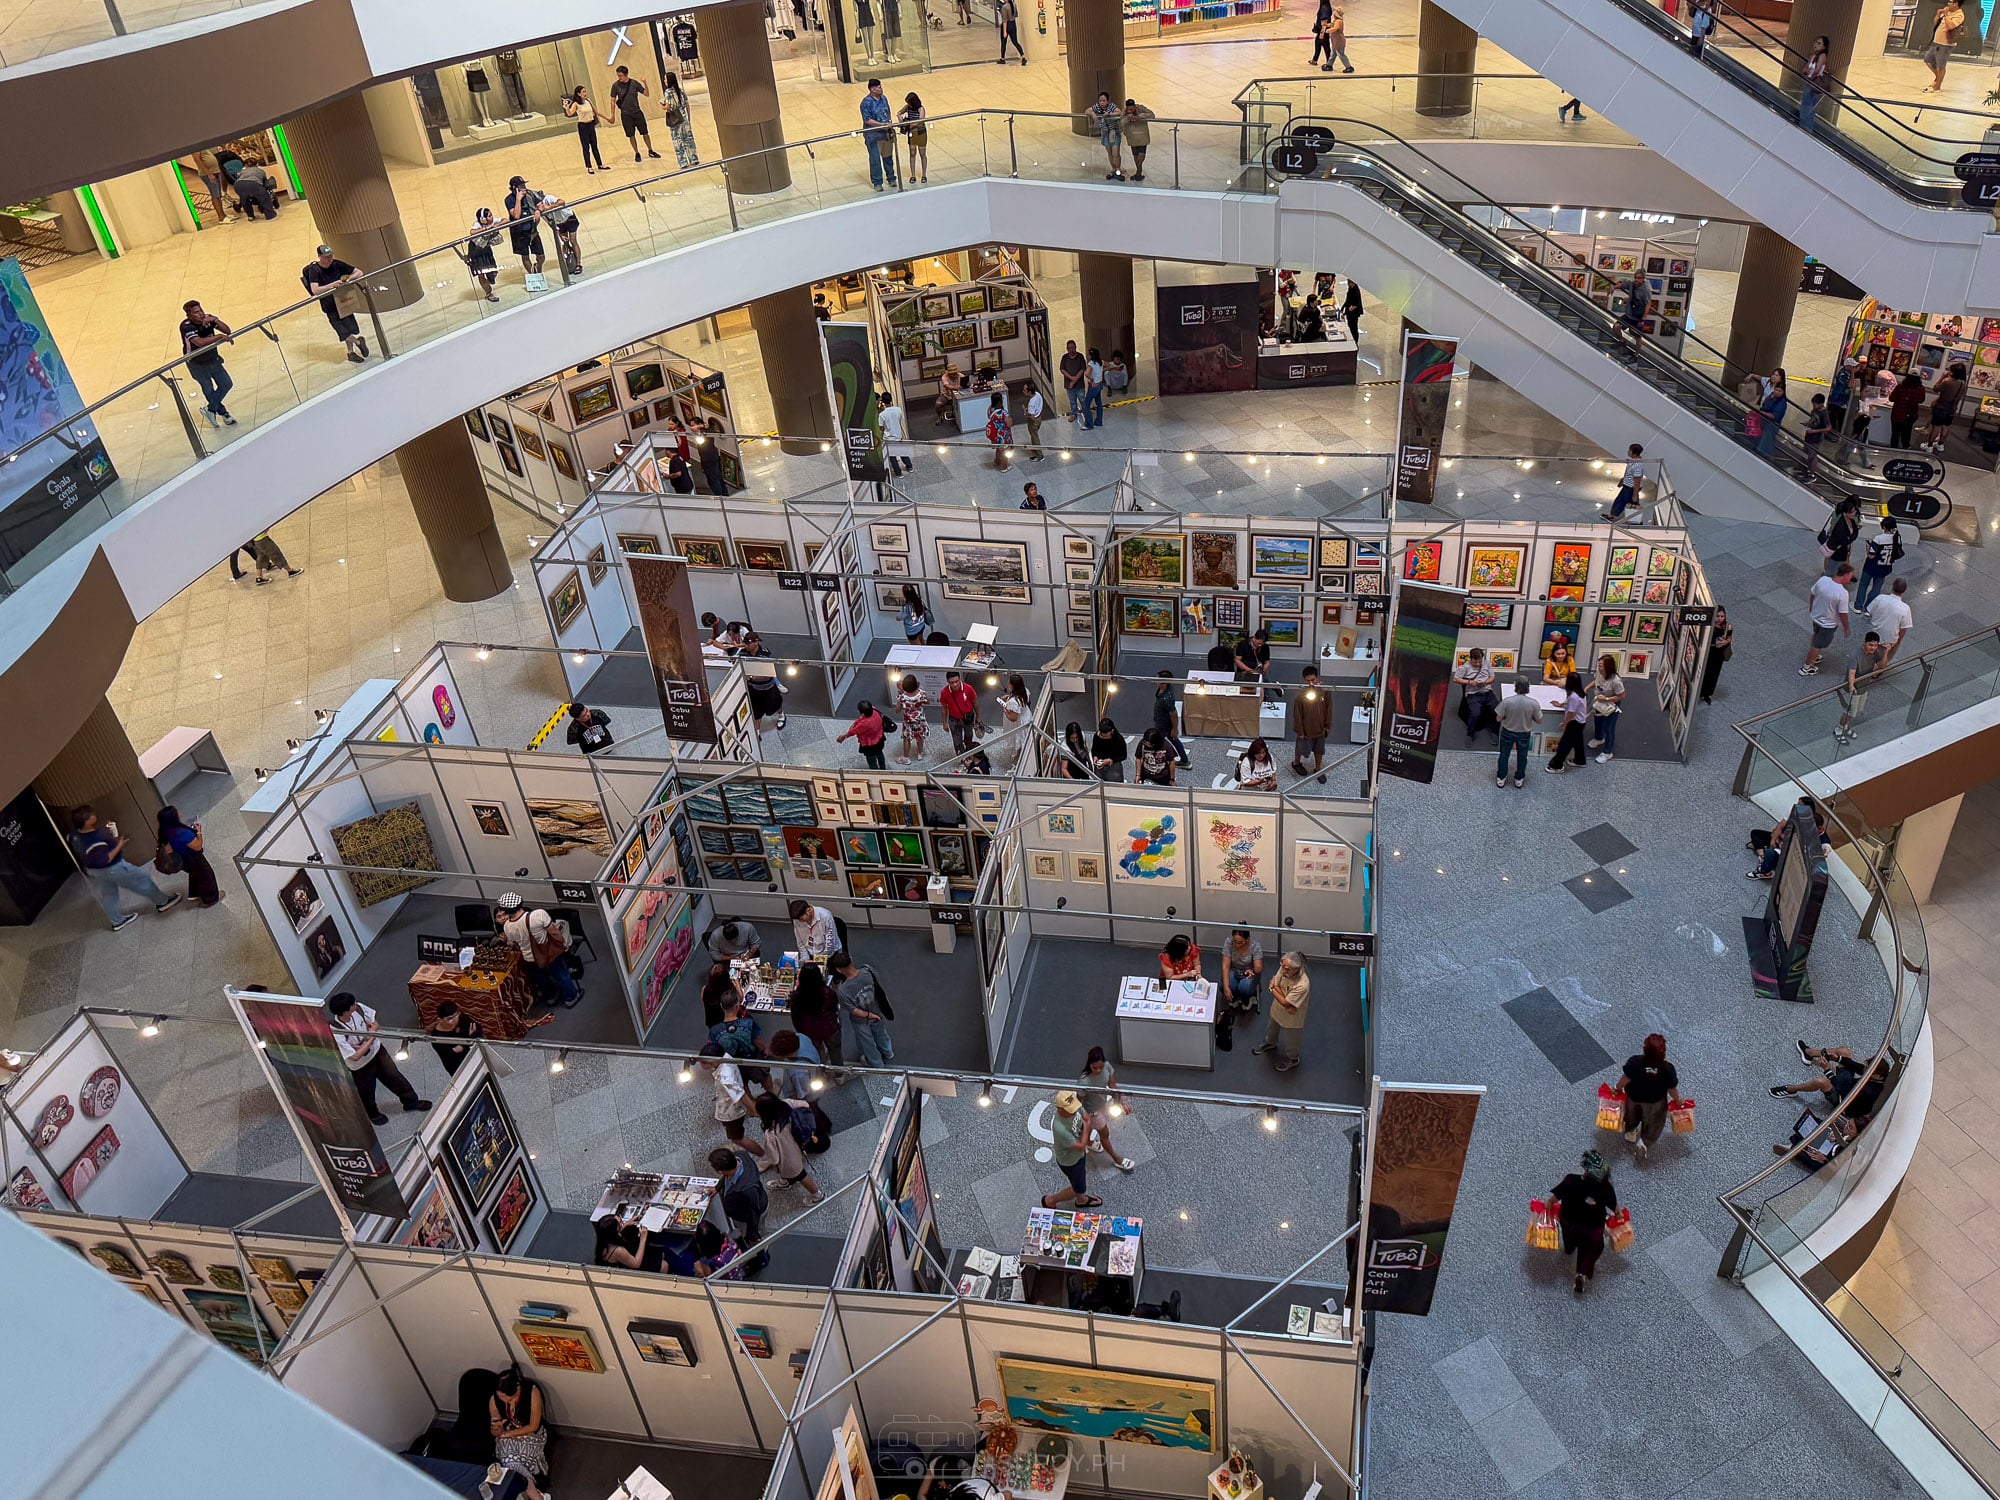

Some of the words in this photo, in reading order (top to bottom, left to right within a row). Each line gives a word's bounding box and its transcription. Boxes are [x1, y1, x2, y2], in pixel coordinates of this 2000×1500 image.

[1305, 134, 1320, 147] L2
[1286, 155, 1302, 168] L2
[1979, 184, 2000, 200] L2
[707, 381, 720, 391] R20
[1400, 468, 1417, 476] Cebu
[1399, 481, 1411, 489] Fair
[58, 482, 78, 502] center
[63, 494, 78, 510] cebu
[1905, 500, 1922, 514] L1
[784, 578, 802, 586] R22
[817, 580, 834, 588] R28
[1364, 601, 1383, 609] R34
[670, 688, 696, 700] TUBÔ
[673, 720, 689, 728] Fair
[1396, 725, 1424, 737] TUBÔ
[1389, 740, 1411, 750] Cebu
[1388, 748, 1401, 756] Art
[1387, 754, 1403, 764] Fair
[562, 889, 587, 899] R24
[938, 911, 963, 920] R30
[1339, 942, 1365, 951] R36
[333, 1155, 367, 1169] TUBÔ
[337, 1173, 364, 1184] Cebu
[342, 1181, 357, 1190] Art
[345, 1188, 365, 1198] Fair
[1377, 1248, 1417, 1263] TUBÔ
[1367, 1270, 1399, 1280] Cebu
[1365, 1279, 1385, 1287] Art
[1364, 1287, 1389, 1296] Fair
